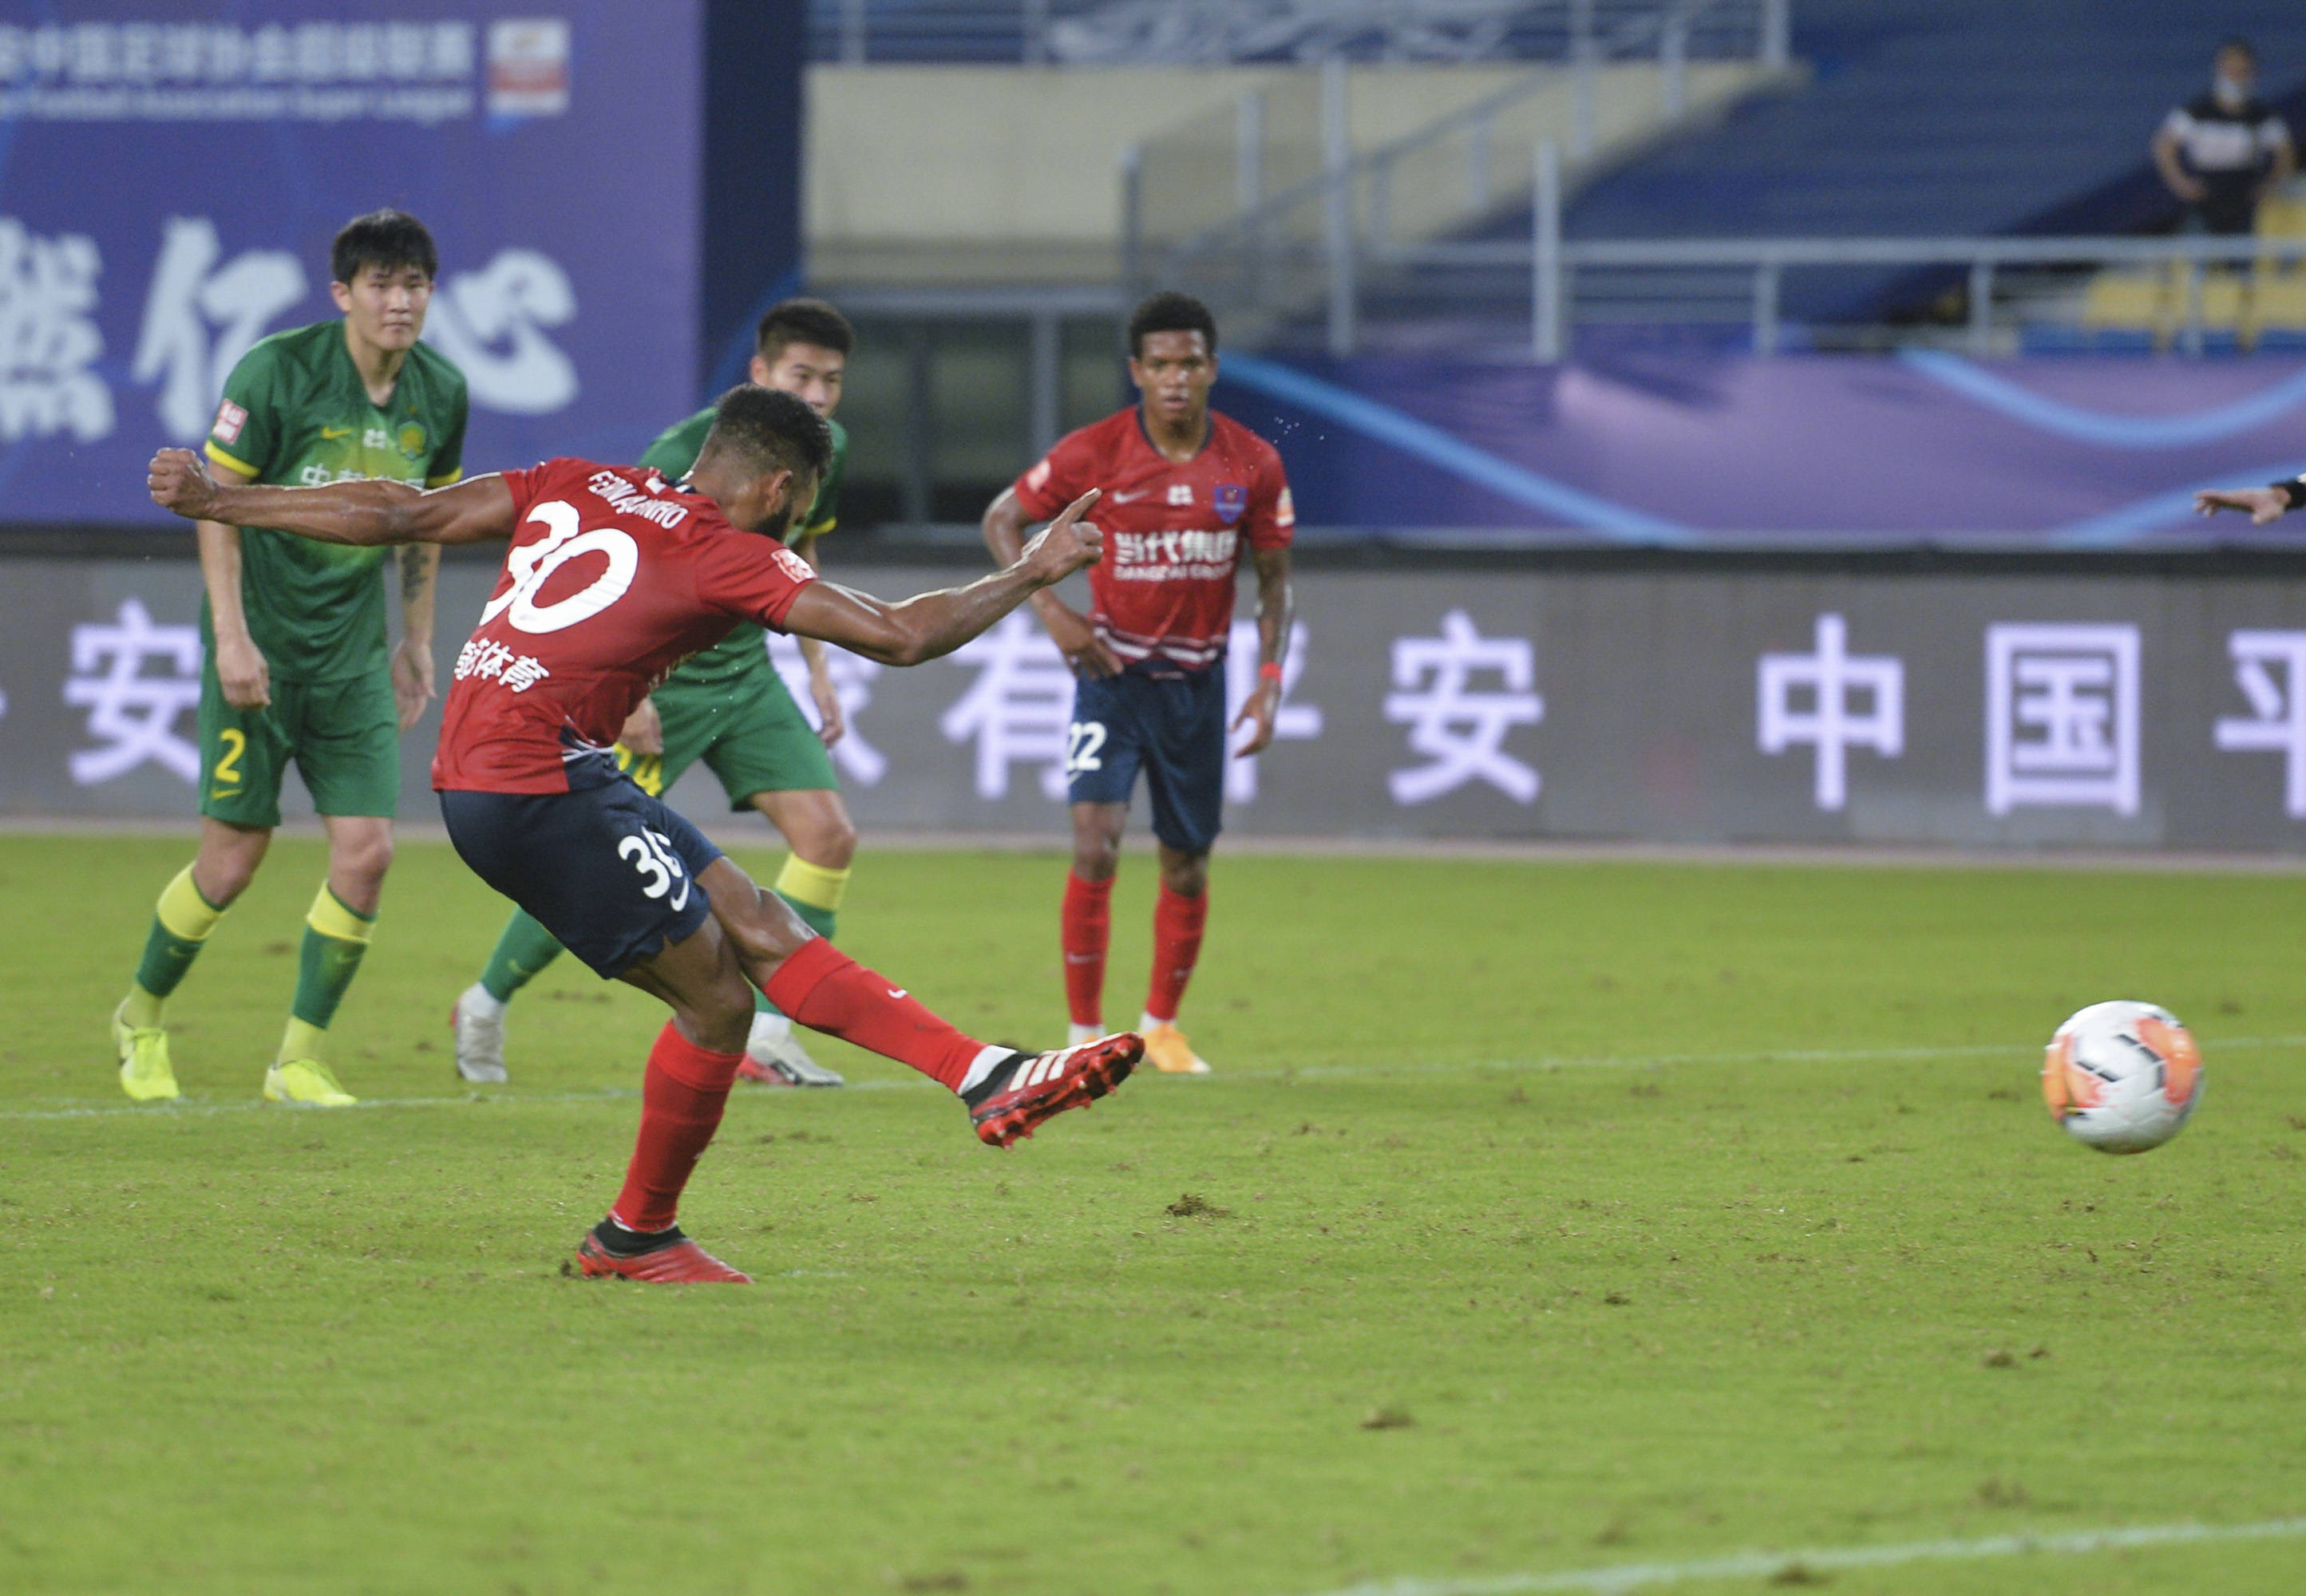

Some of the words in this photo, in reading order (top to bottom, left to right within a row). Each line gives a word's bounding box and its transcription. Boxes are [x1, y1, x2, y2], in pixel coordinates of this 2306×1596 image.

[480, 500, 639, 634] 30
[0, 598, 202, 786] 安
[214, 727, 246, 783] 2
